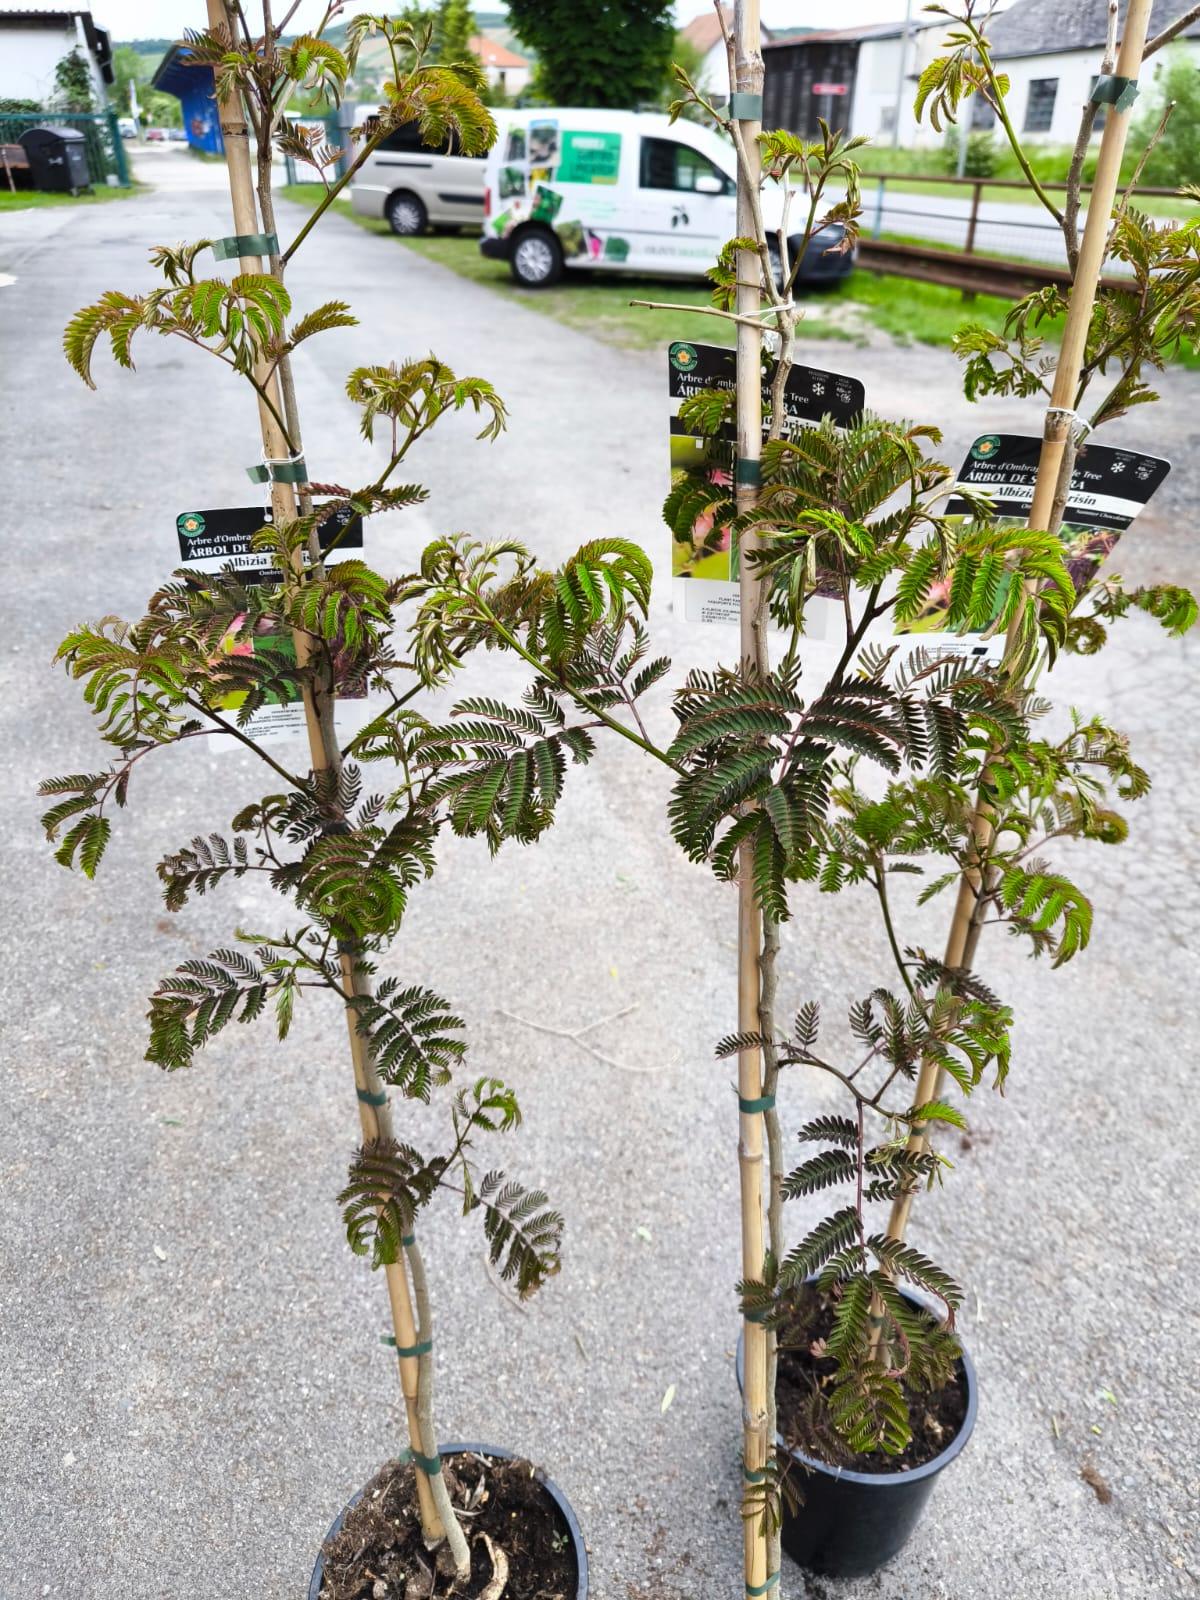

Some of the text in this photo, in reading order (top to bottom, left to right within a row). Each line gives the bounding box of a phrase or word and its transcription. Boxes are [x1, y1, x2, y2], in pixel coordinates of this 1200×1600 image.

[676, 372, 703, 384] Arbre
[790, 392, 809, 404] Tree
[964, 469, 1008, 484] ÁRBOL
[1010, 474, 1027, 485] DE
[969, 460, 997, 470] Arbre
[1084, 470, 1102, 481] Tree
[187, 533, 252, 547] Arbre d'Ombra
[188, 545, 230, 558] ÁRBOL
[232, 543, 249, 554] DE
